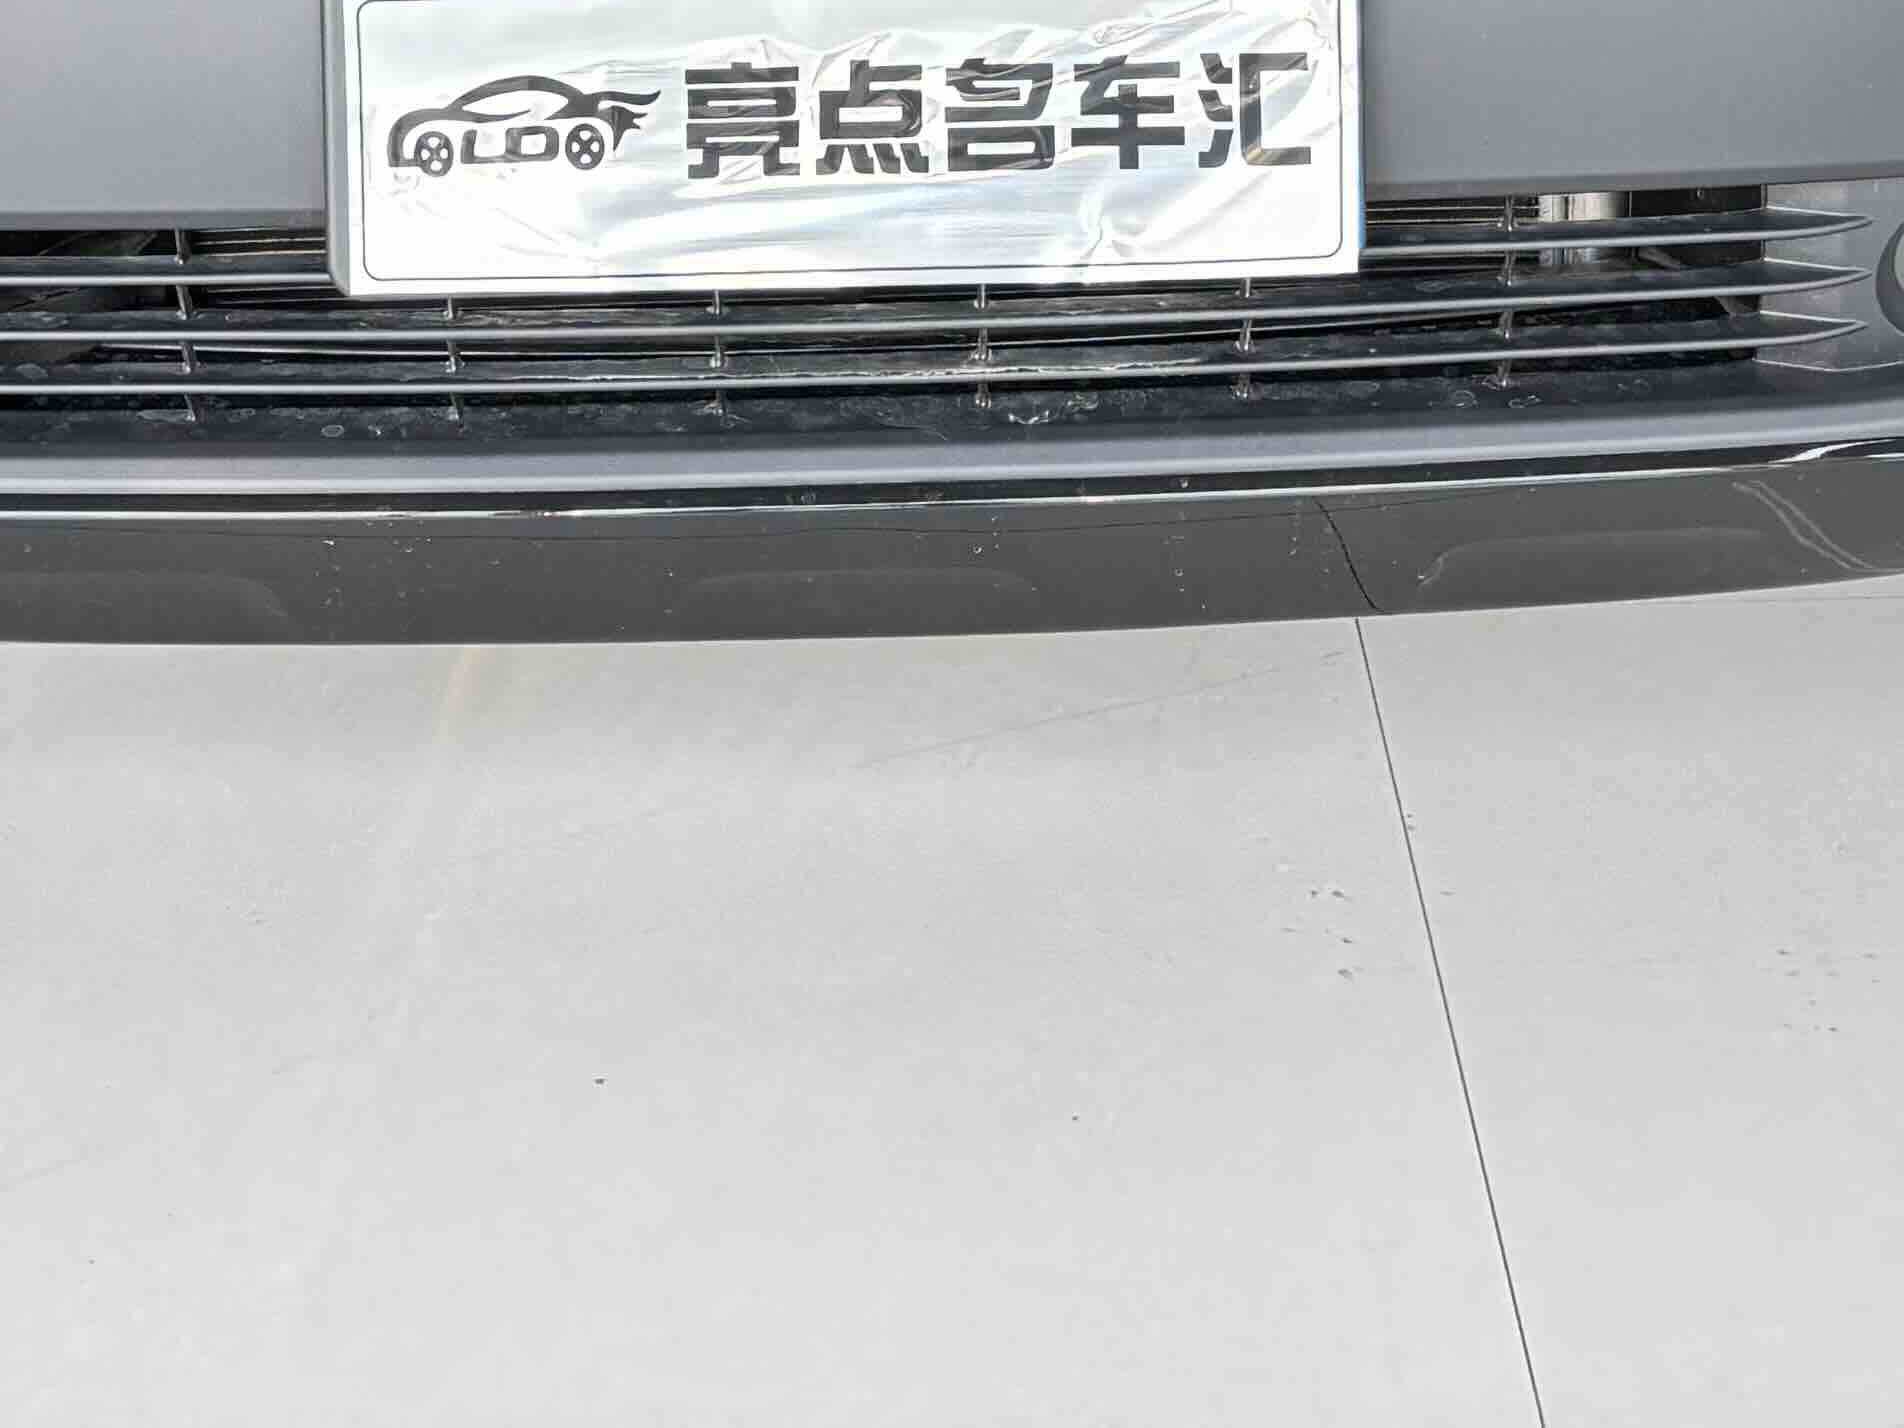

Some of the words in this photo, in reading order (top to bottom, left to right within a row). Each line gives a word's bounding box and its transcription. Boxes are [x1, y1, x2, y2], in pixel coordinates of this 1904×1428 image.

[684, 52, 1312, 180] 亮点名车汇
